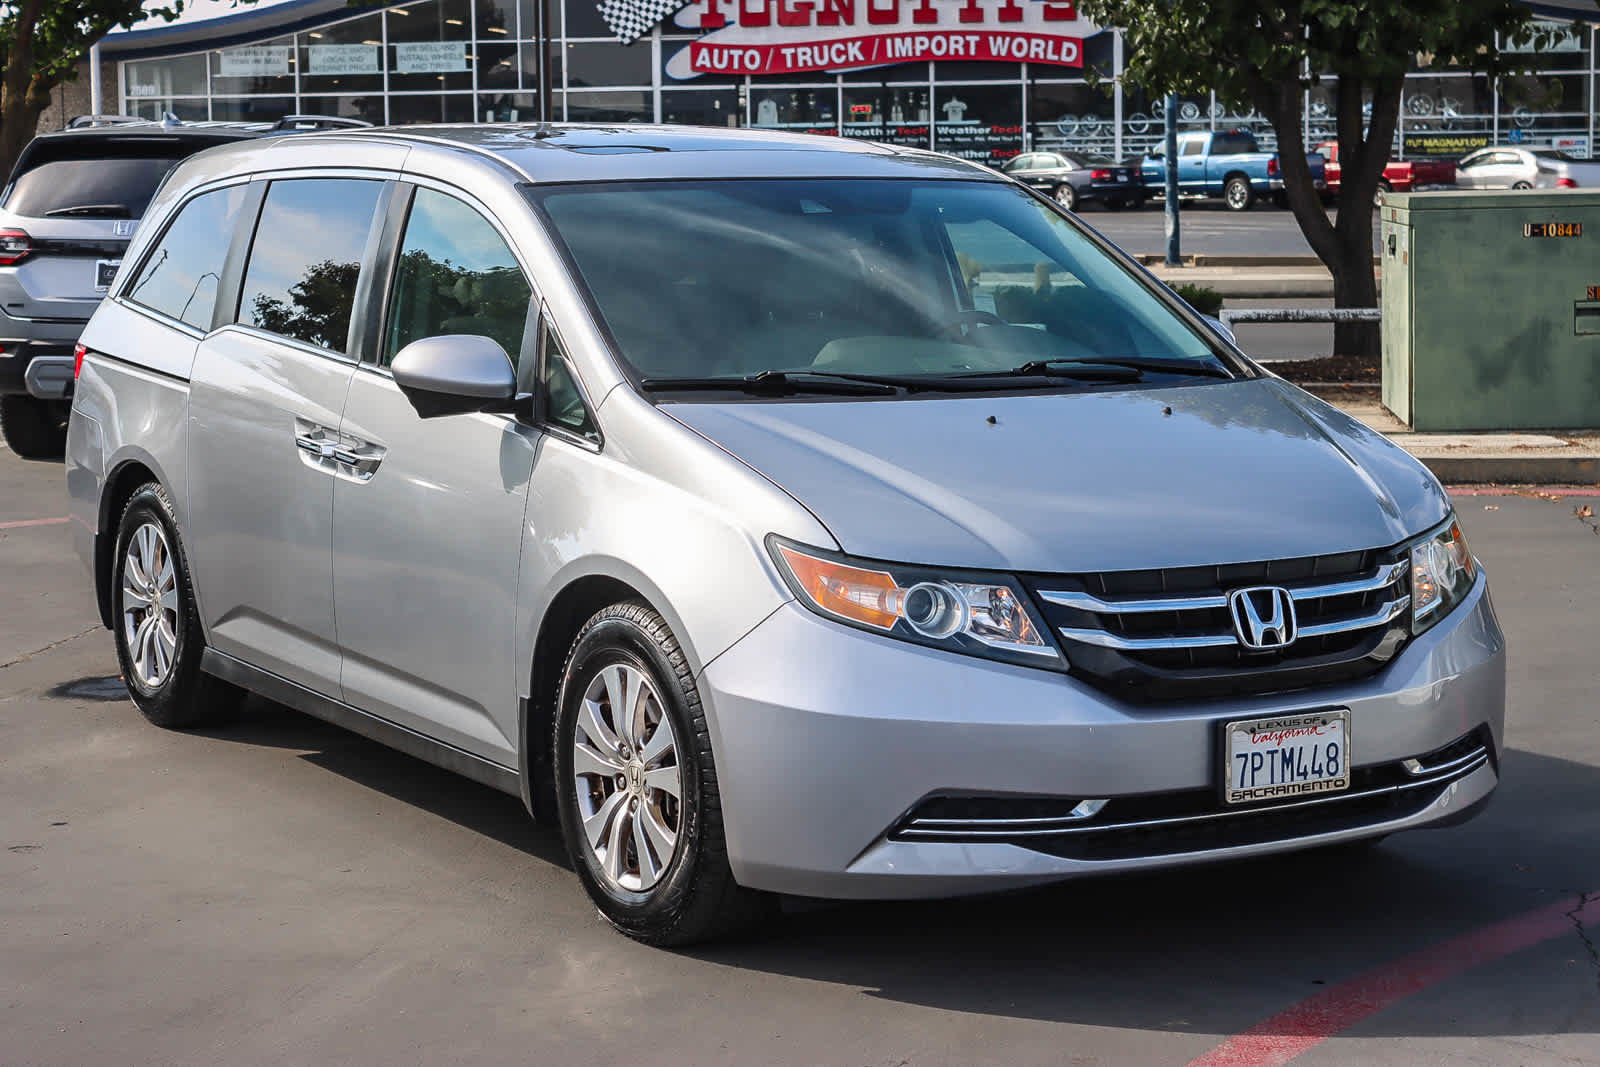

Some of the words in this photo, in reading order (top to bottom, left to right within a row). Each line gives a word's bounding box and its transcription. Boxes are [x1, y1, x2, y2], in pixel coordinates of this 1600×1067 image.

[696, 48, 761, 70] AUTO
[781, 41, 864, 68] TRUCK
[886, 35, 980, 58] IMPORT
[988, 36, 1078, 62] WORLD
[843, 127, 928, 136] WeathrTech
[1257, 720, 1301, 730] LEXUS
[1303, 717, 1321, 725] OF
[1252, 726, 1325, 746] California
[1235, 742, 1339, 788] 7PTM448
[1231, 779, 1346, 801] SACRAMENTO
